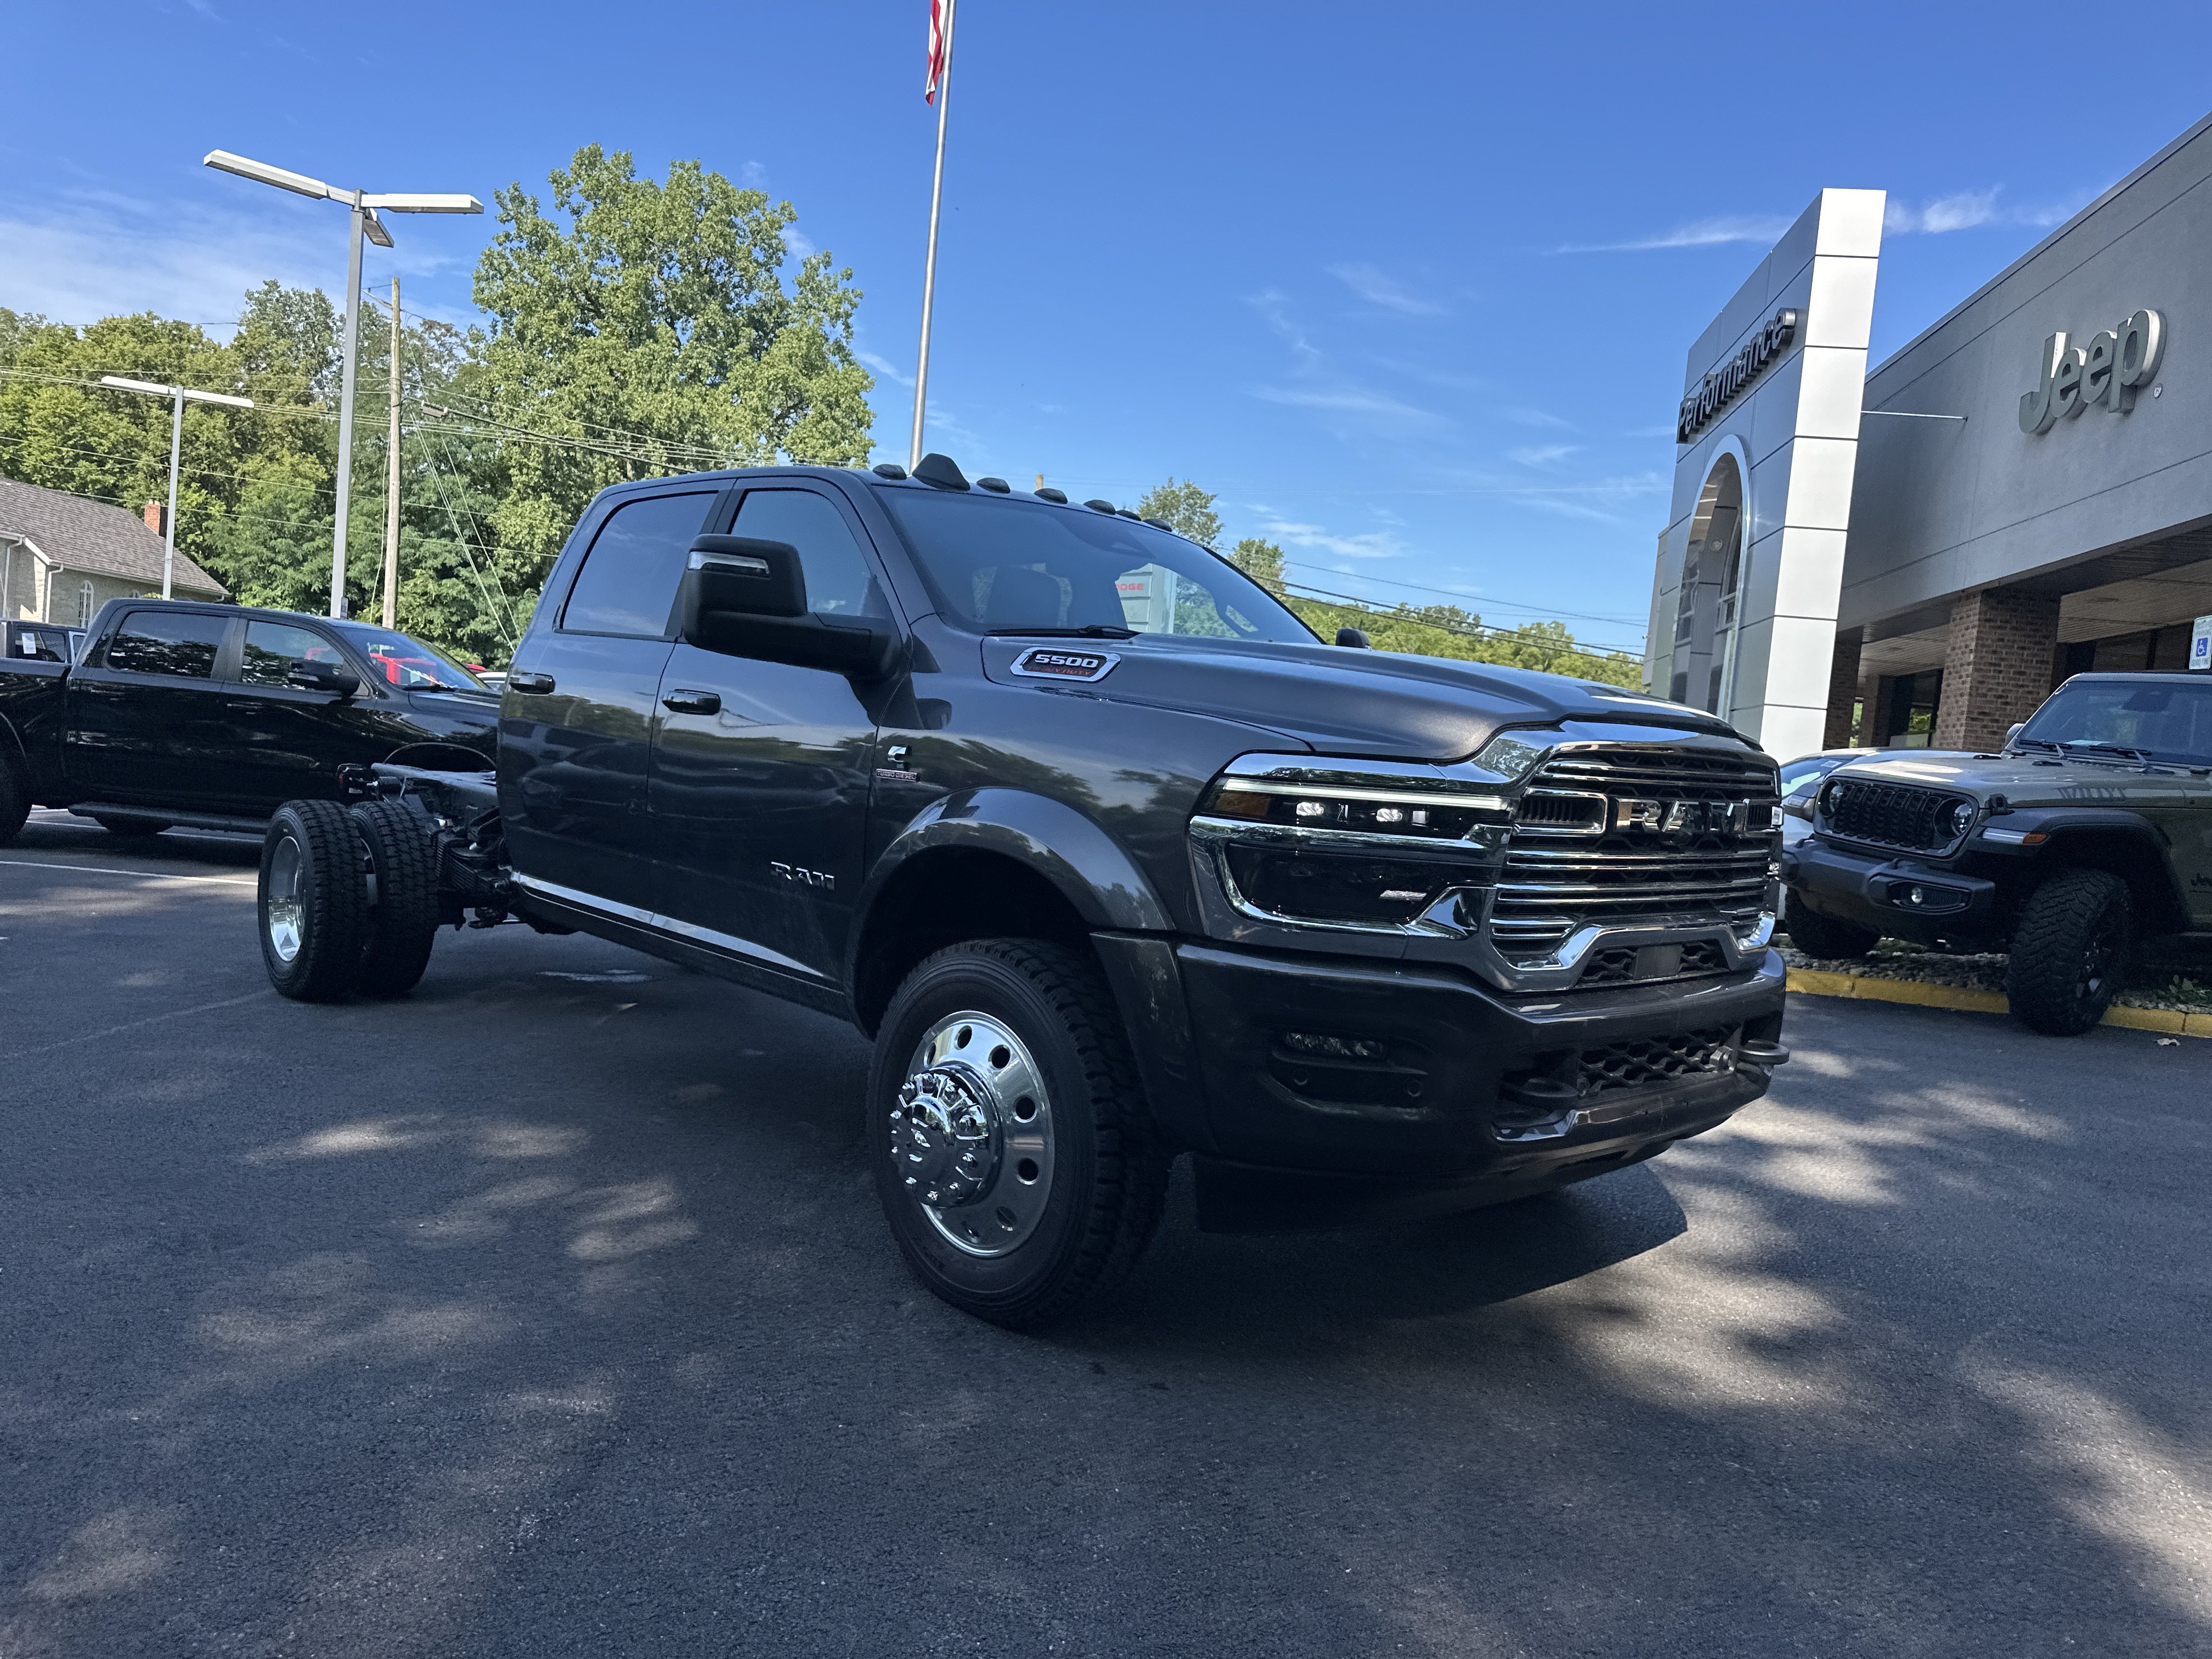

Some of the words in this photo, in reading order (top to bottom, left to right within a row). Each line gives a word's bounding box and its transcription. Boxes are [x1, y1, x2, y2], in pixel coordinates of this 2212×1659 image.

[1677, 307, 1796, 443] Performance
[2019, 309, 2160, 433] Jeep
[1035, 654, 1099, 668] 5500
[895, 772, 917, 780] DIESEL
[1616, 798, 1746, 834] RAM
[771, 861, 834, 890] RAM
